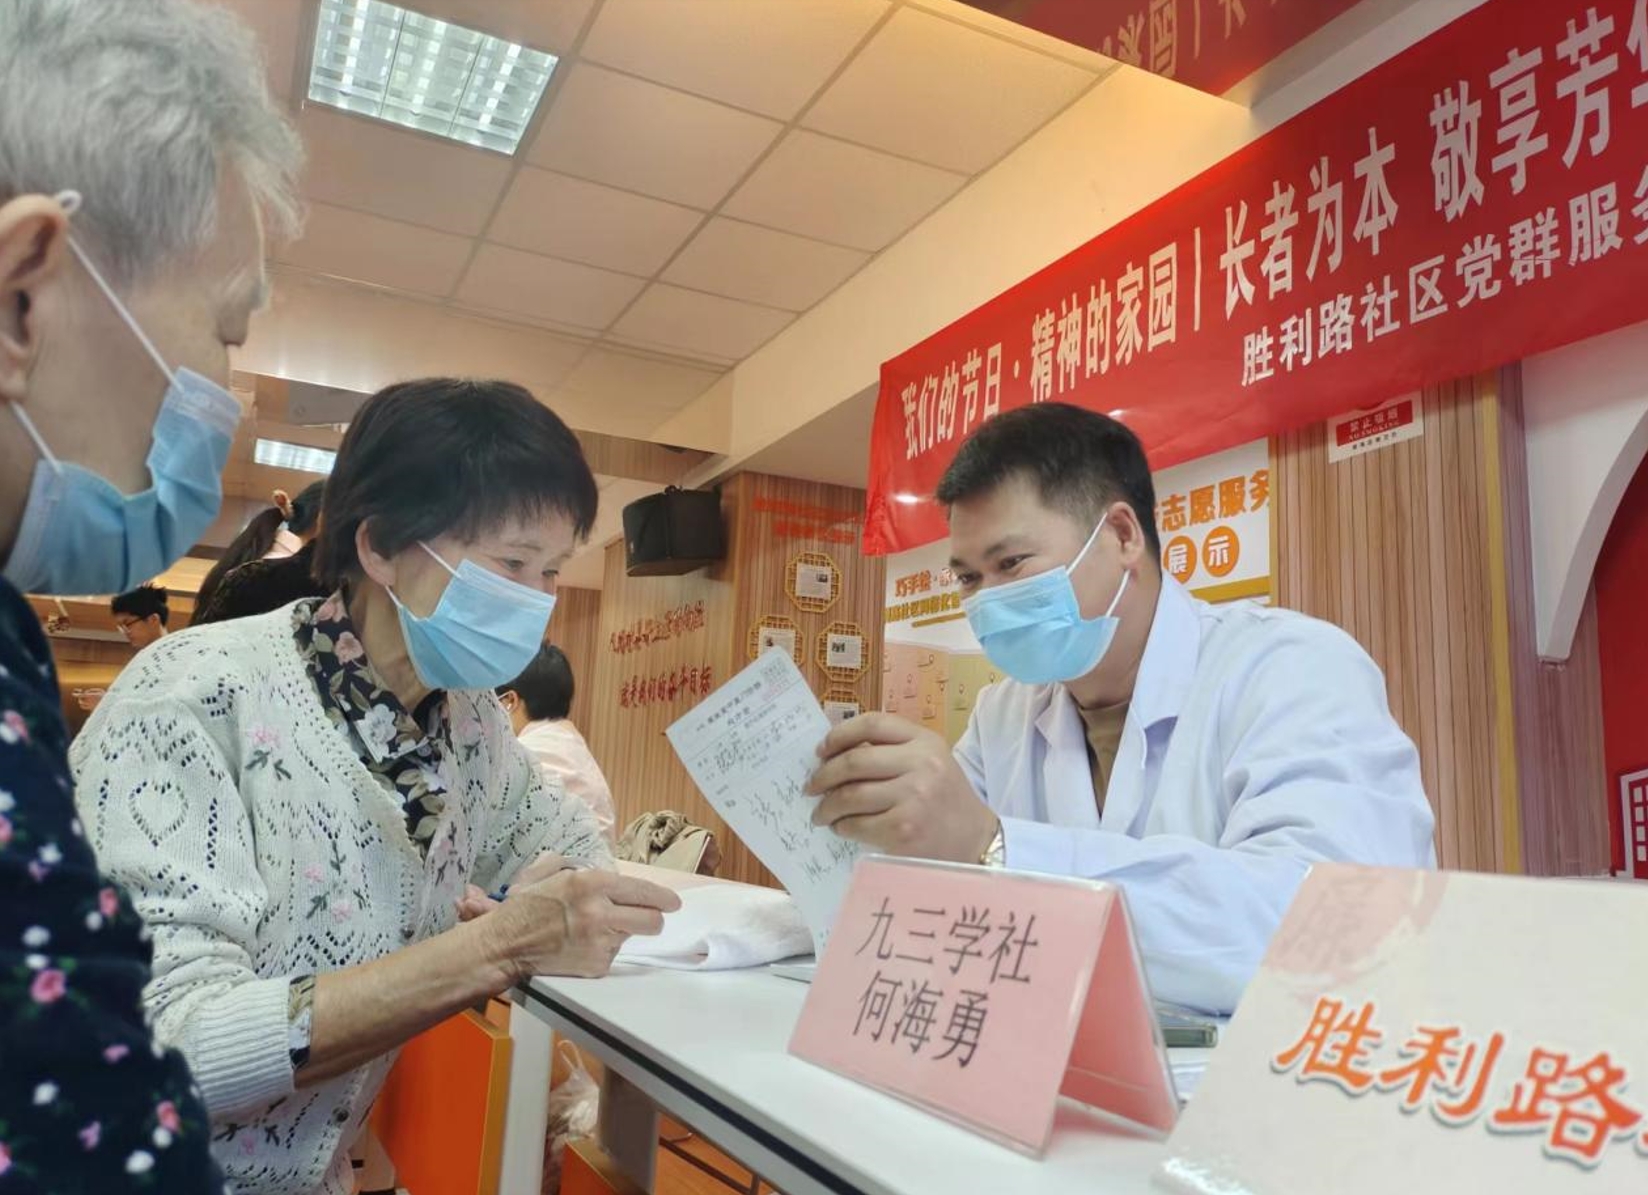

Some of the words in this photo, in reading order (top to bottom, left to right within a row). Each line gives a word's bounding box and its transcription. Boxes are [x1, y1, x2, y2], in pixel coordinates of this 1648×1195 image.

[1155, 469, 1268, 532] 志愿服务
[855, 896, 1039, 985] 九三学社
[852, 970, 989, 1068] 何海勇
[1276, 997, 1648, 1159] 胜利路
